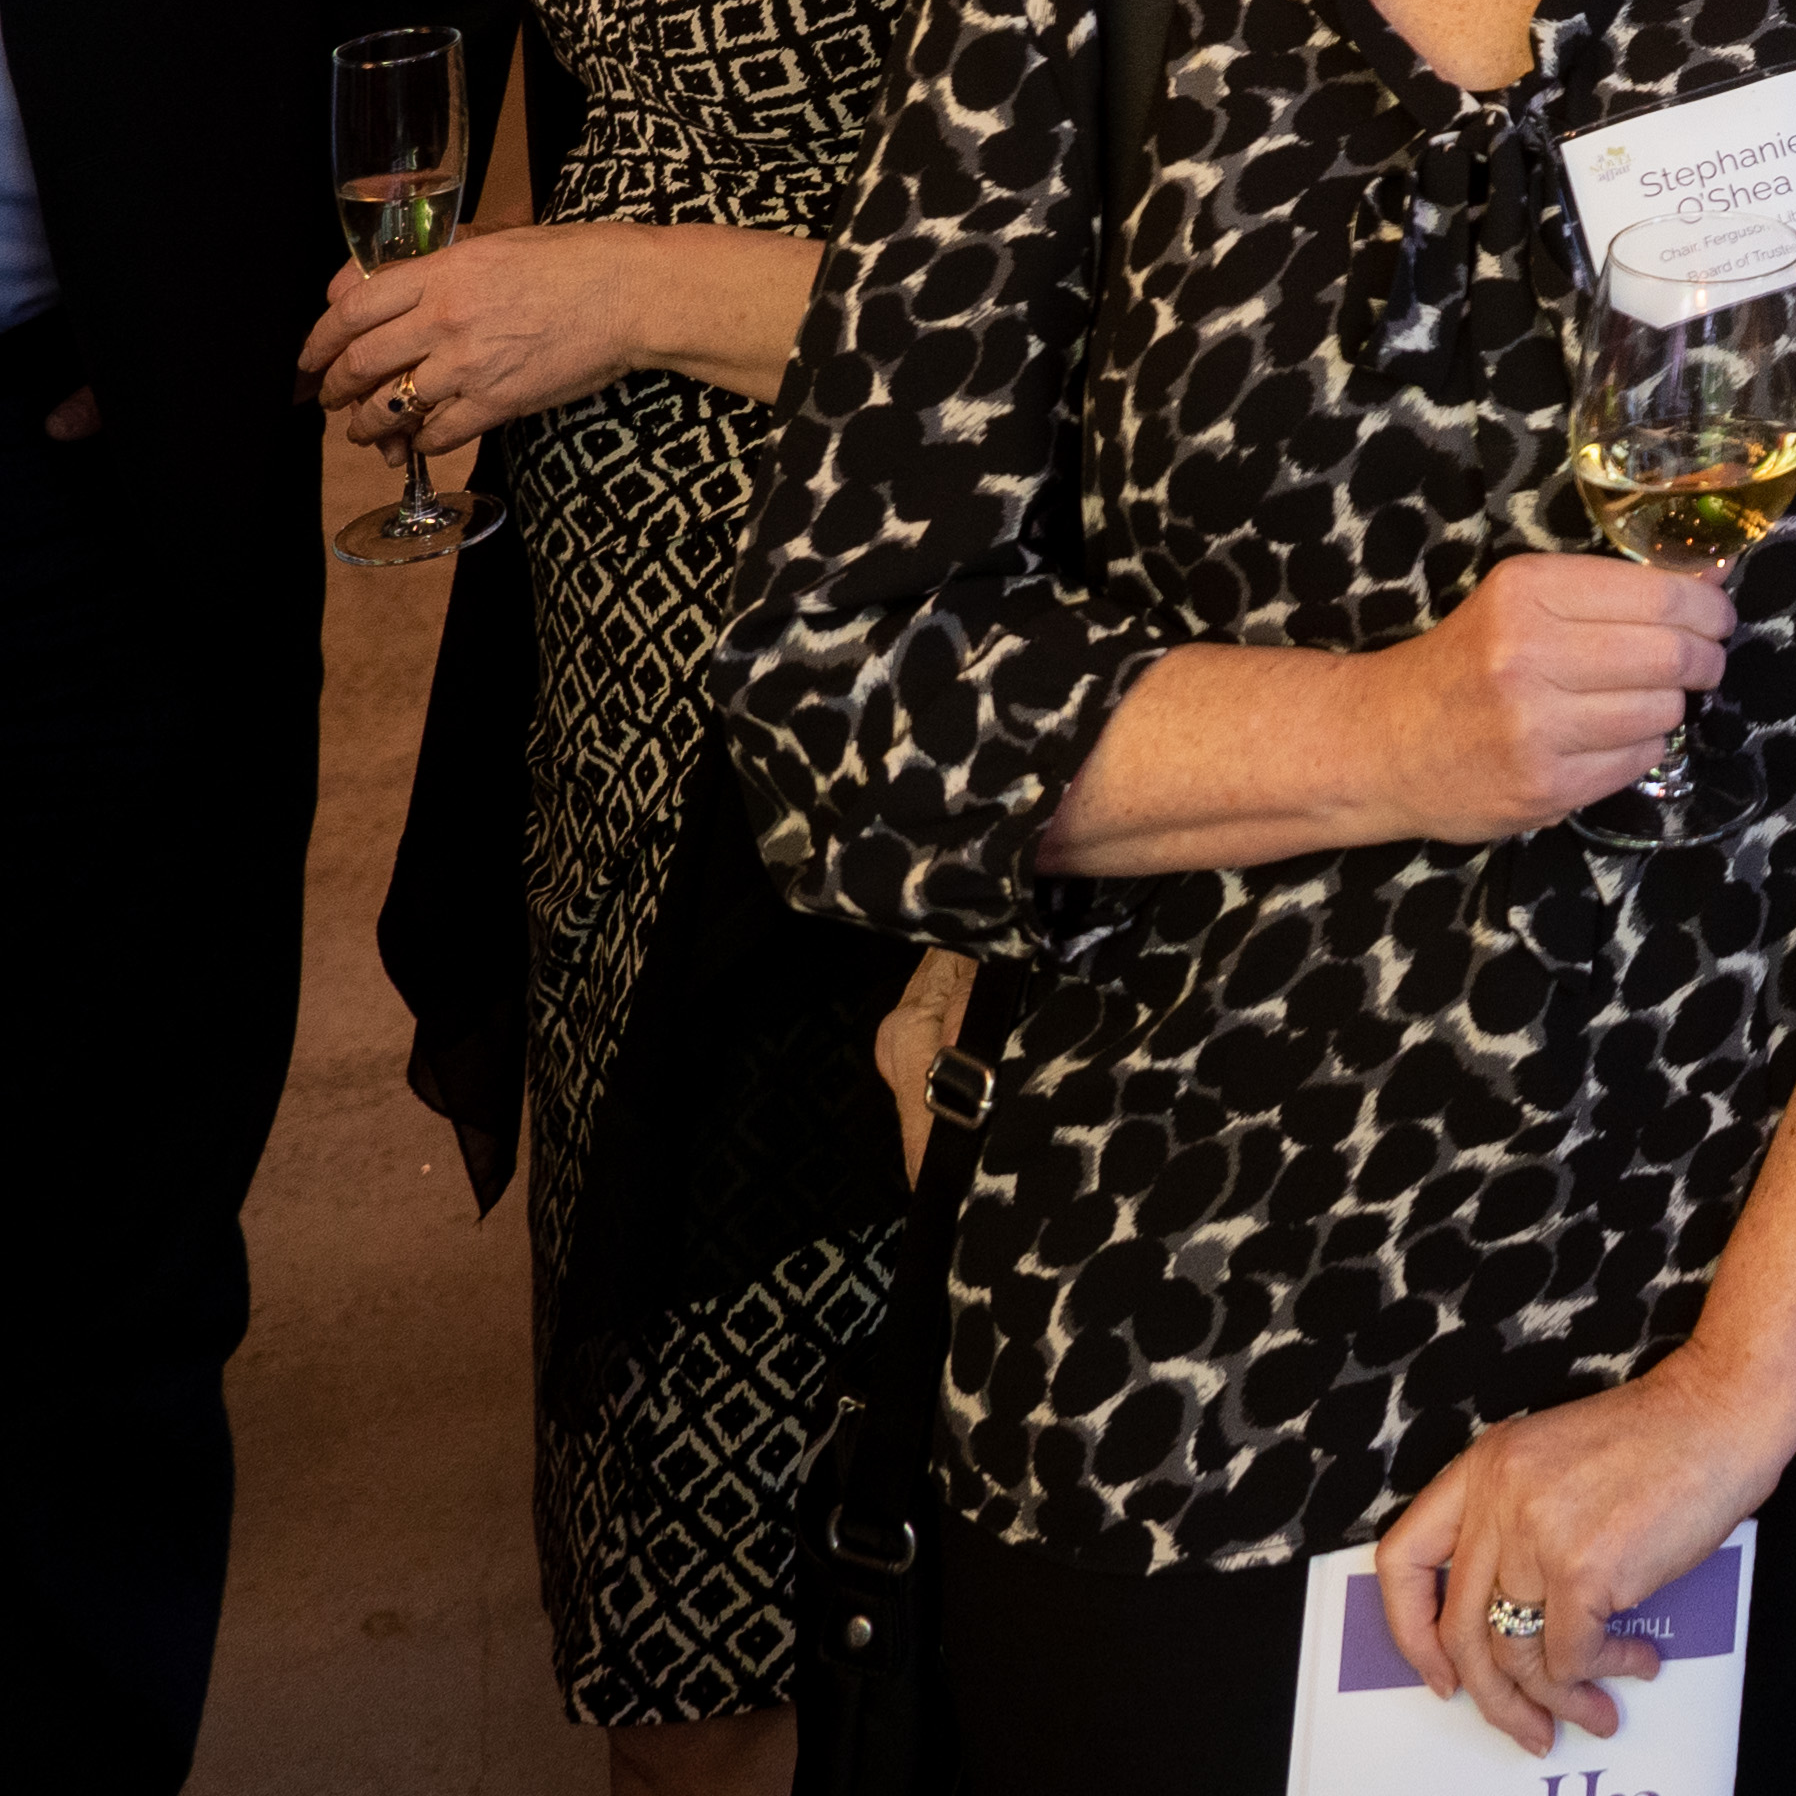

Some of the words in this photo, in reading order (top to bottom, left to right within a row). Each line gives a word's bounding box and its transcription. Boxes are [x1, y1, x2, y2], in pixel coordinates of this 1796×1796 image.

[1677, 175, 1793, 225] O'Shea
[1687, 260, 1732, 282] Board
[1735, 253, 1752, 269] of
